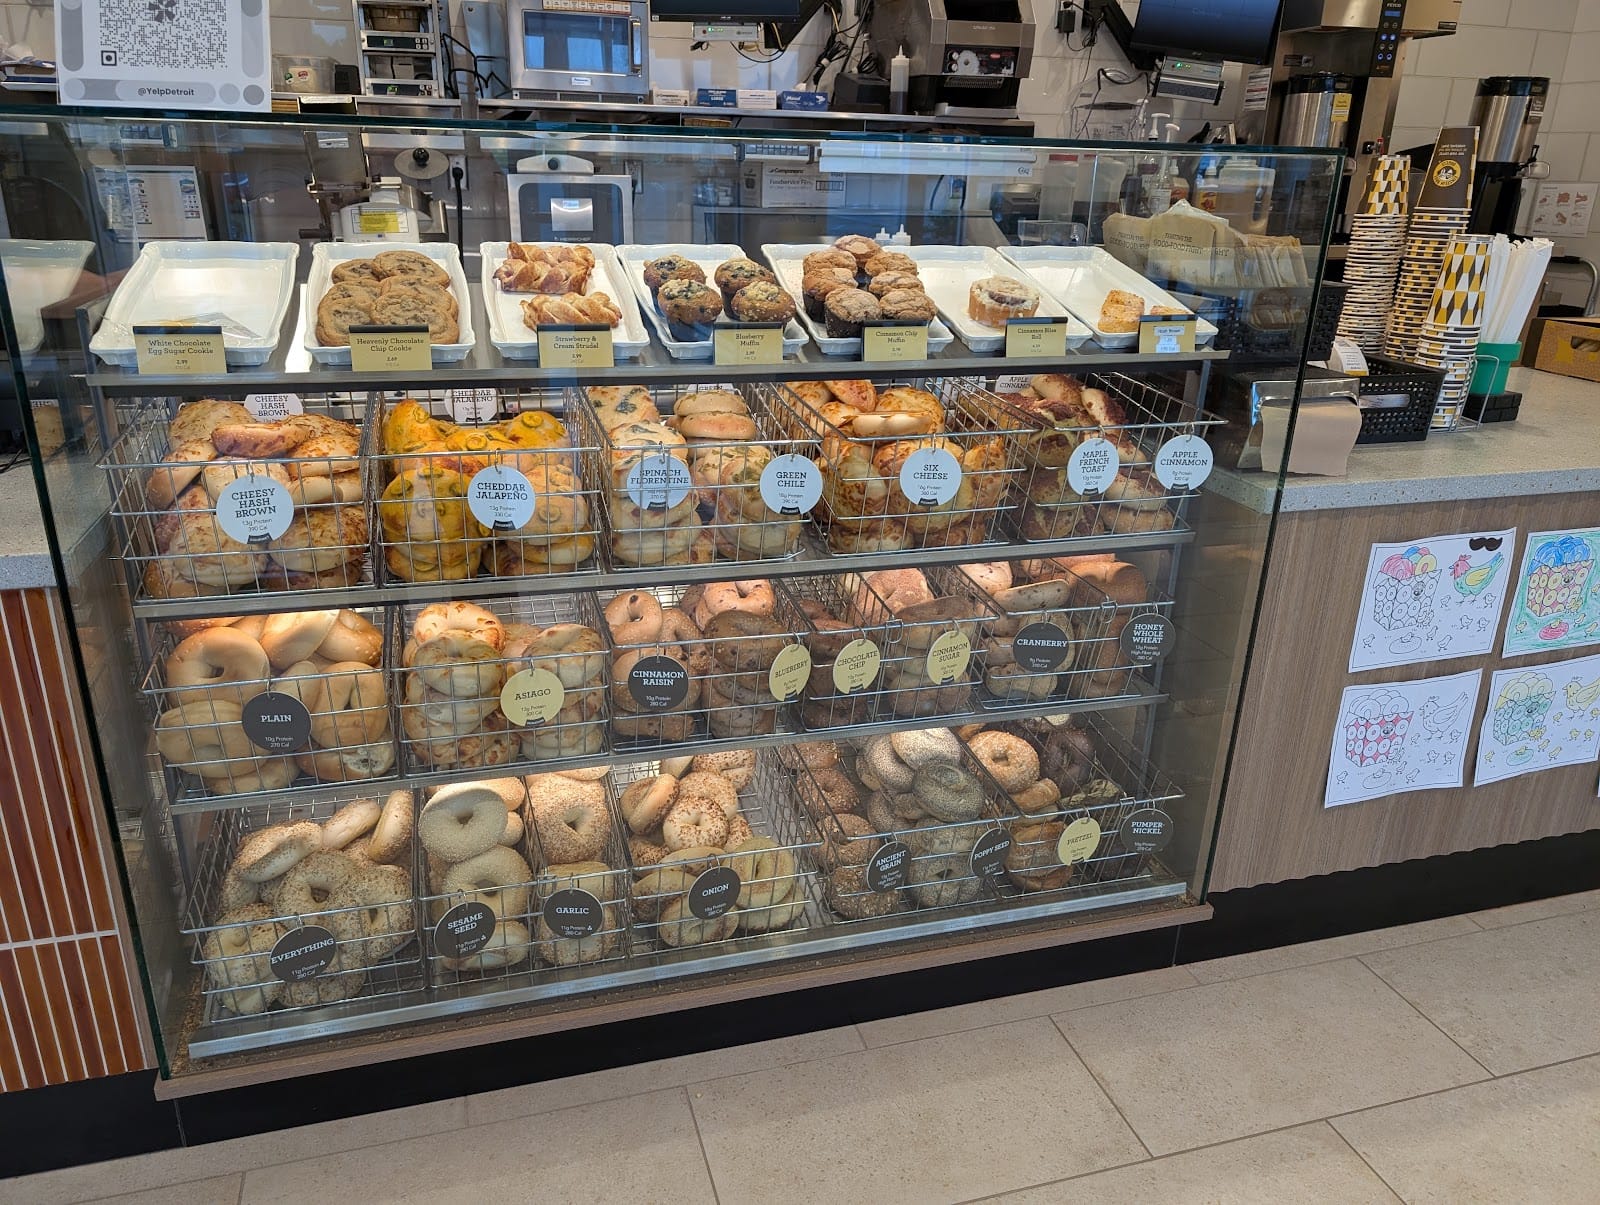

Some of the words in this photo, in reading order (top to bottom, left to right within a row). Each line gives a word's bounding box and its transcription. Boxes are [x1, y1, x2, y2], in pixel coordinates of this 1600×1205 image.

[138, 87, 195, 97] @YelpDetroit
[904, 330, 918, 338] Chip
[148, 339, 172, 347] White
[173, 339, 211, 347] Chocolate
[356, 338, 389, 346] Heavenly
[555, 335, 591, 343] Strawberry
[148, 347, 162, 355] Egg
[164, 347, 186, 355] Sugar
[370, 345, 387, 353] Chip
[261, 402, 285, 410] HASH
[258, 409, 290, 417] BROWN
[1082, 450, 1108, 458] MAPLE
[1079, 458, 1109, 466] FRENCH
[923, 464, 939, 472] SIX
[1081, 465, 1106, 473] TOAST
[776, 471, 807, 479] GREEN
[477, 482, 525, 491] CHEDDAR
[777, 480, 805, 488] CHILE
[231, 488, 276, 501] CHEESY
[475, 491, 528, 501] JALAPEÑO
[239, 497, 270, 508] HASH
[235, 505, 276, 518] BROWN
[1017, 639, 1067, 647] CRANBERRY
[932, 643, 968, 657] CINNAMON
[837, 651, 878, 667] CHOCOLATE
[939, 652, 960, 662] SUGAR
[775, 659, 808, 677] BLUEBERRY
[848, 661, 866, 670] CHIP
[633, 670, 684, 679] CINNAMON
[515, 688, 551, 700] ASIAGO
[261, 714, 292, 723] PLAIN
[1067, 833, 1094, 845] PRETZEL
[974, 846, 994, 860] POPPY
[995, 841, 1010, 850] SEED
[876, 850, 907, 867] ANCIENT
[880, 859, 902, 872] GRAIN
[702, 884, 729, 897] ONION
[447, 912, 483, 929] SESAME
[454, 922, 477, 935] SEED
[271, 938, 334, 964] EVERYTHING
